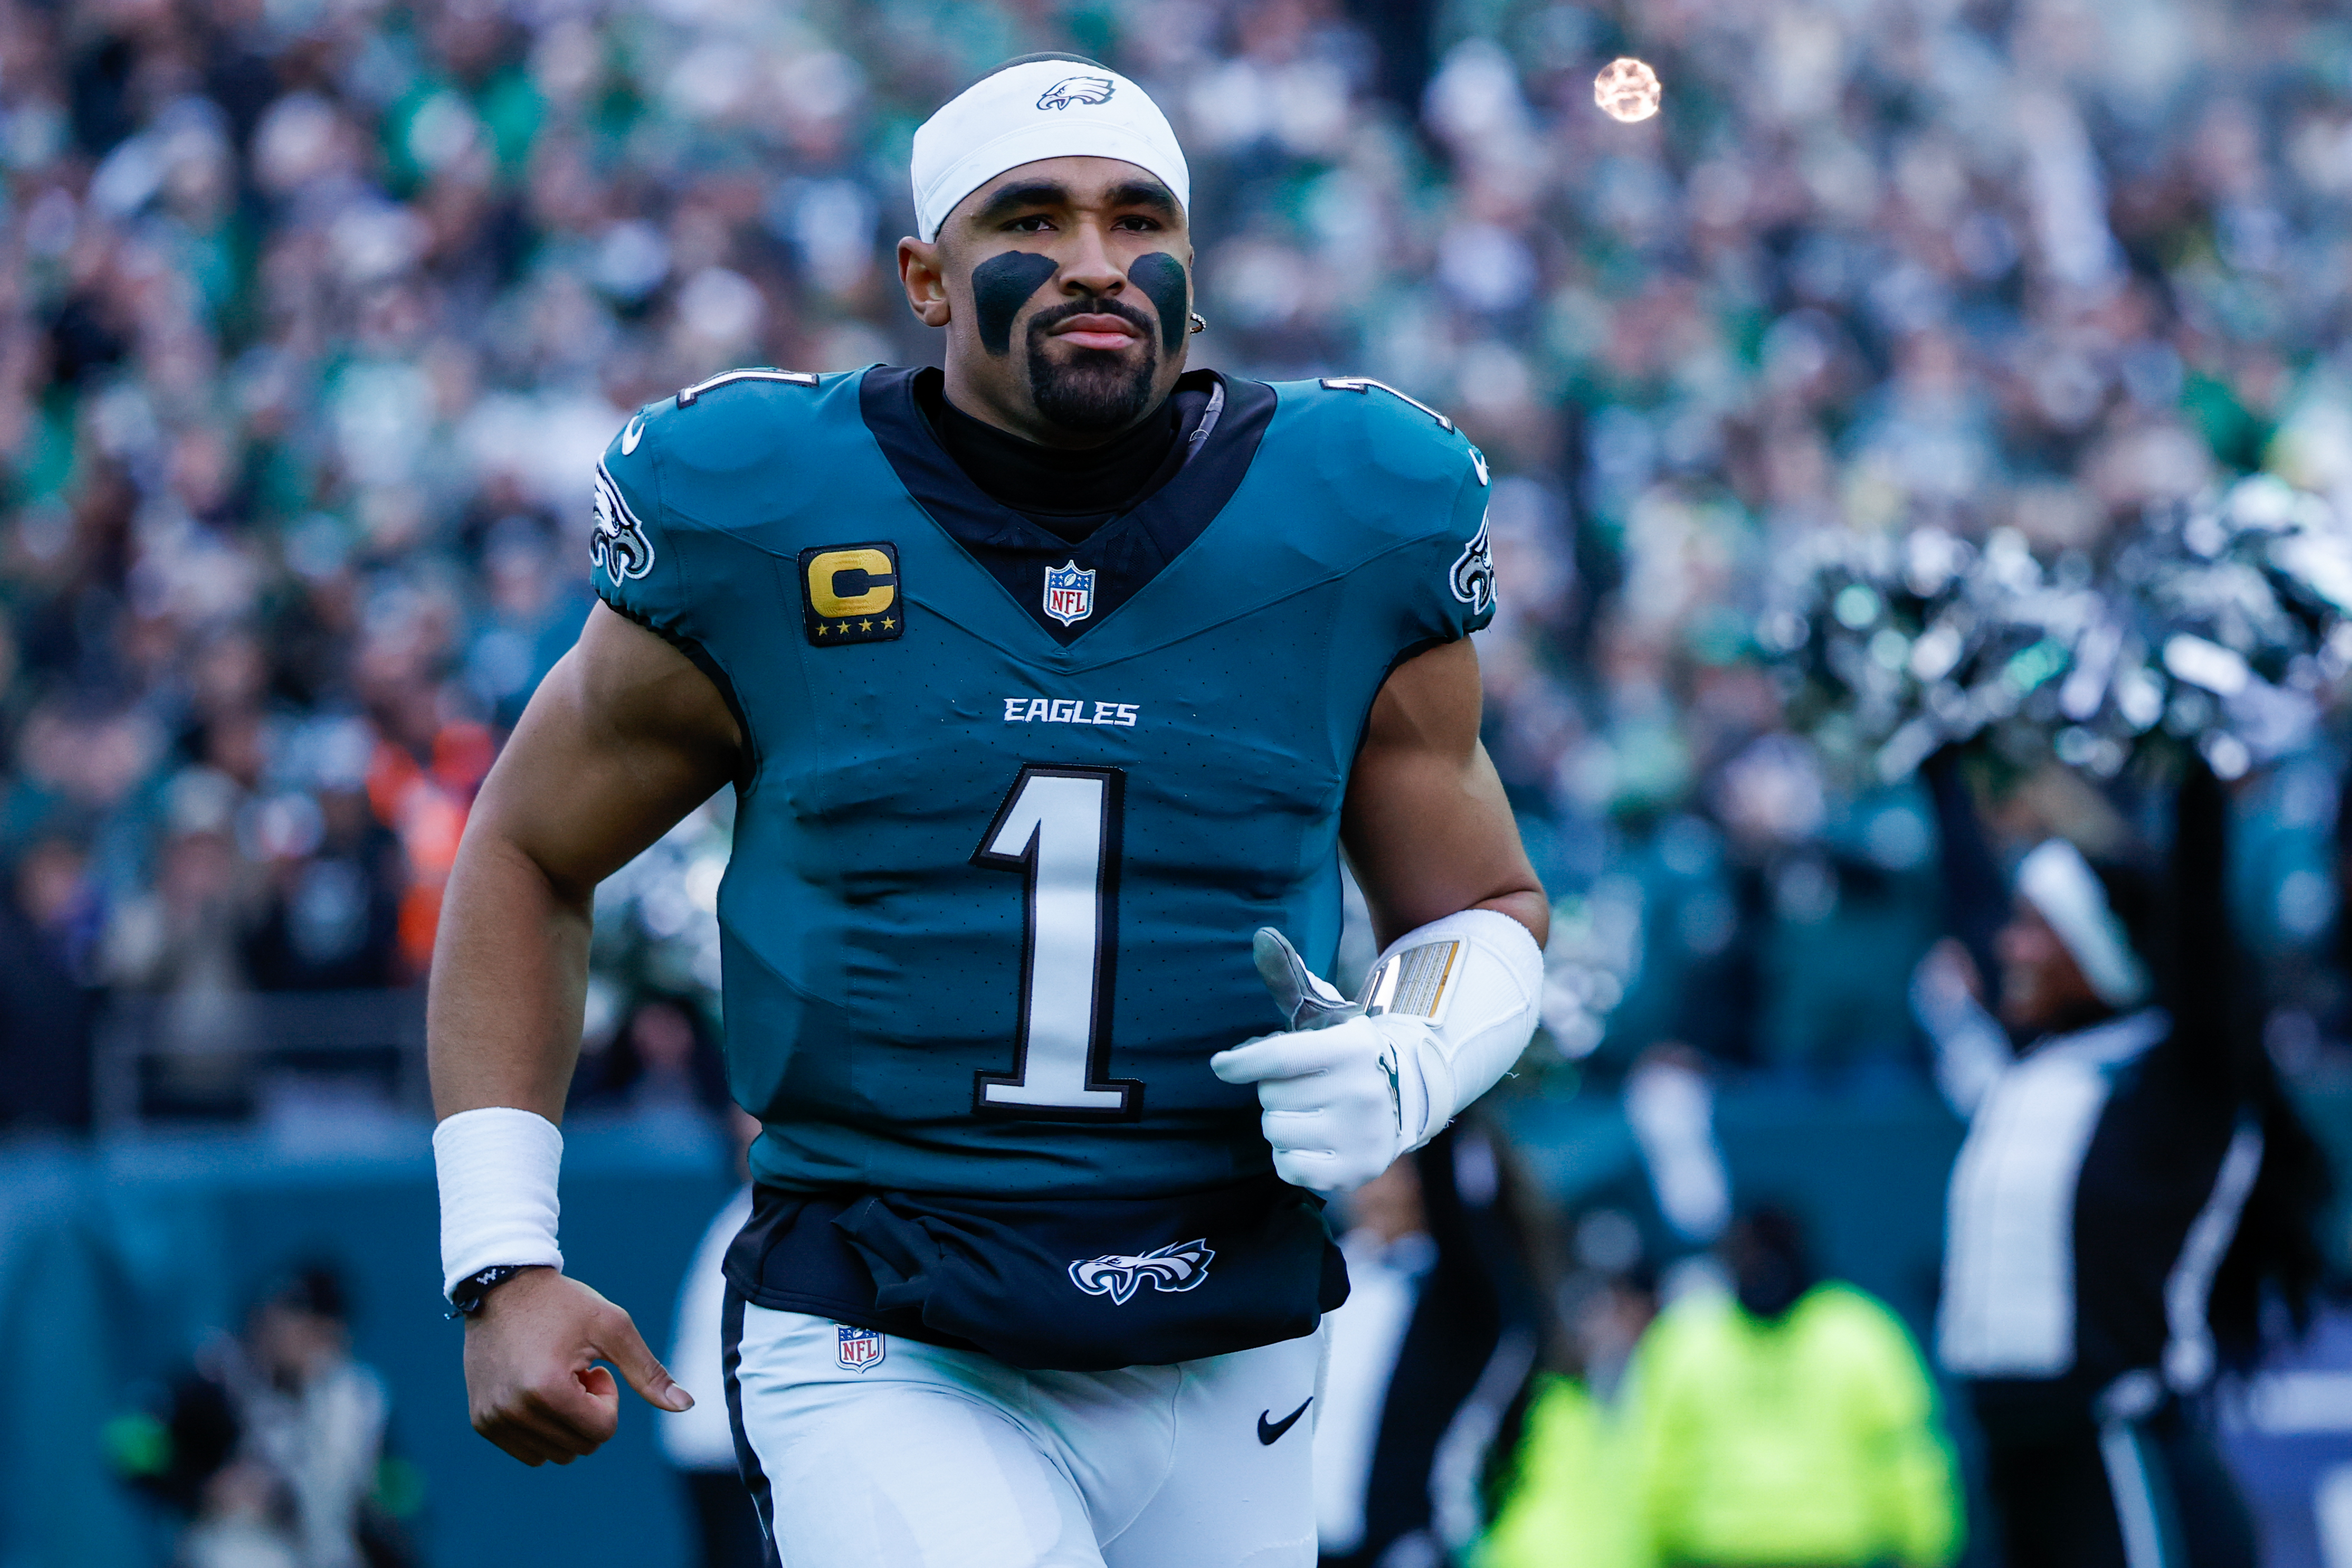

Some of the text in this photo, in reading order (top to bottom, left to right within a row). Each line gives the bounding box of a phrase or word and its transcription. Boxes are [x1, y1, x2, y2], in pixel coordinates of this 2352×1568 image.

[808, 549, 894, 618] C
[1051, 590, 1085, 615] NFL
[1004, 699, 1141, 727] EAGLES
[977, 768, 1132, 1113] 1
[843, 1339, 876, 1362] NFL
